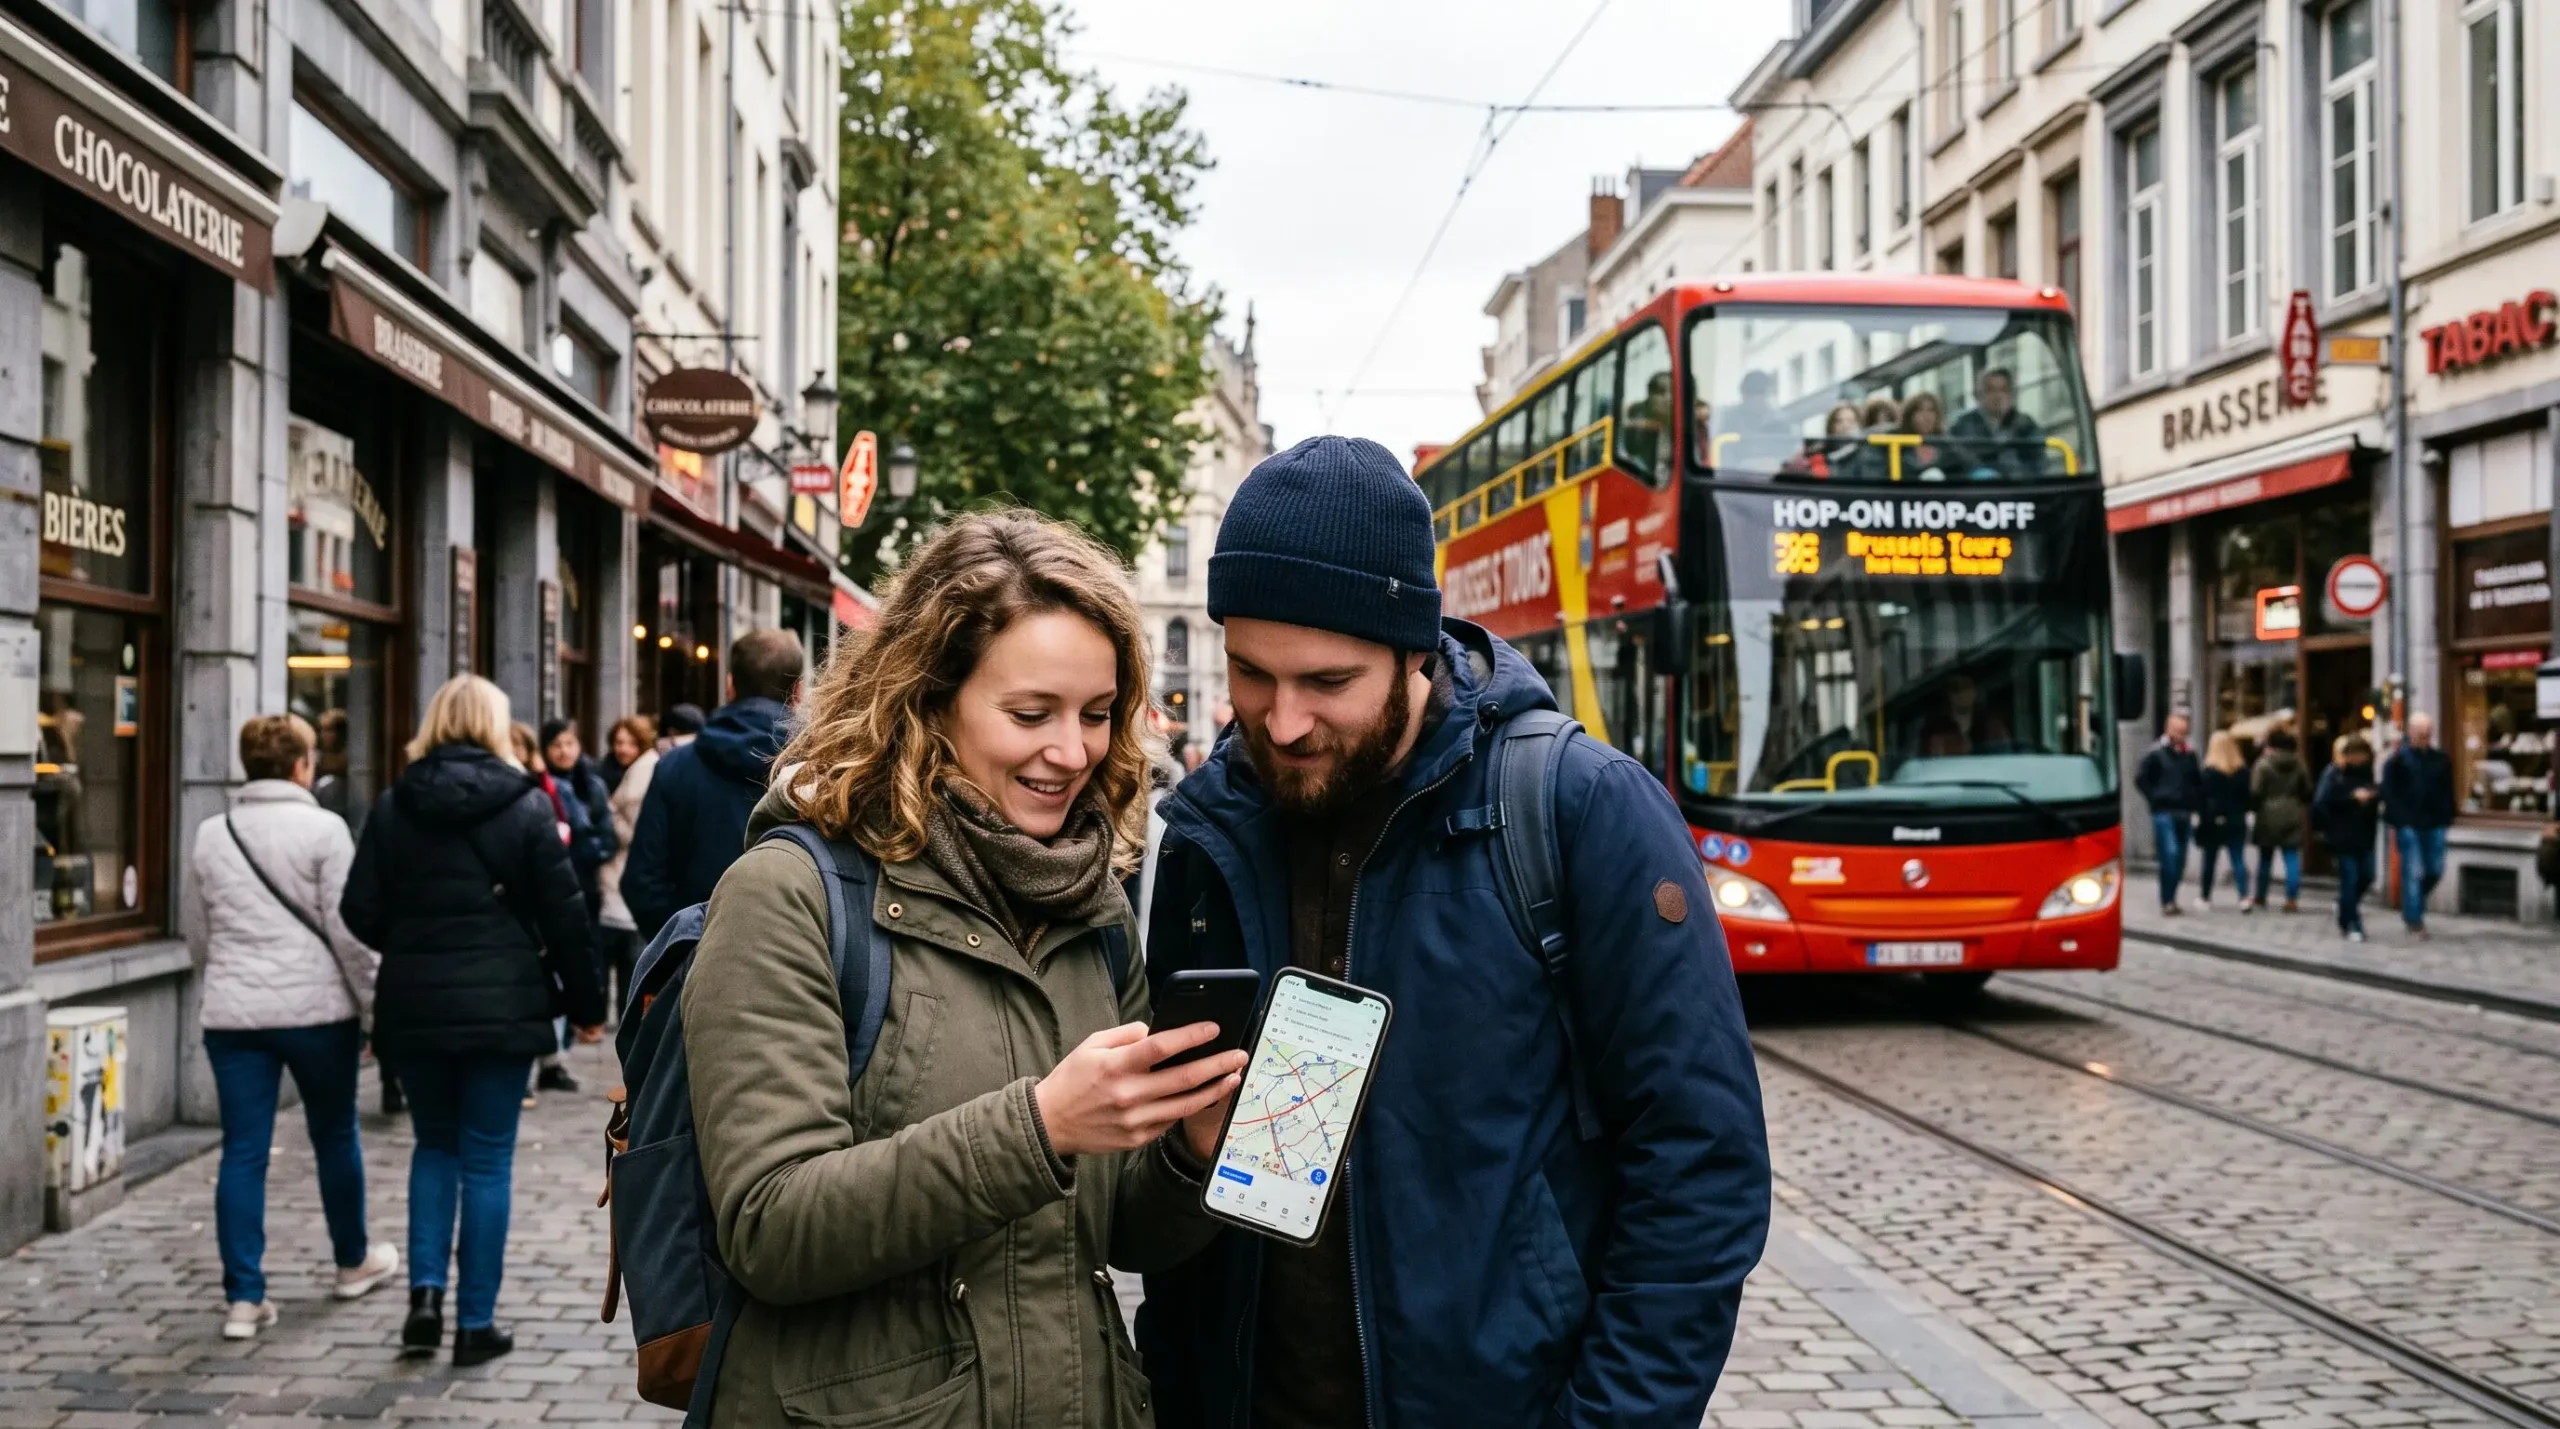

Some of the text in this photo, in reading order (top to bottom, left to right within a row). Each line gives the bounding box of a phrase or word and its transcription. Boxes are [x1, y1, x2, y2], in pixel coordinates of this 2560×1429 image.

[54, 114, 244, 268] CHOCOLATERIE
[2289, 297, 2313, 400] TABAC
[2420, 290, 2557, 375] TABAC
[2163, 376, 2327, 450] BRASSEE
[44, 485, 126, 557] BIÈRES
[1773, 500, 2035, 530] HOP-ON HOP-OFF
[1847, 531, 2012, 558] Brussels Tours
